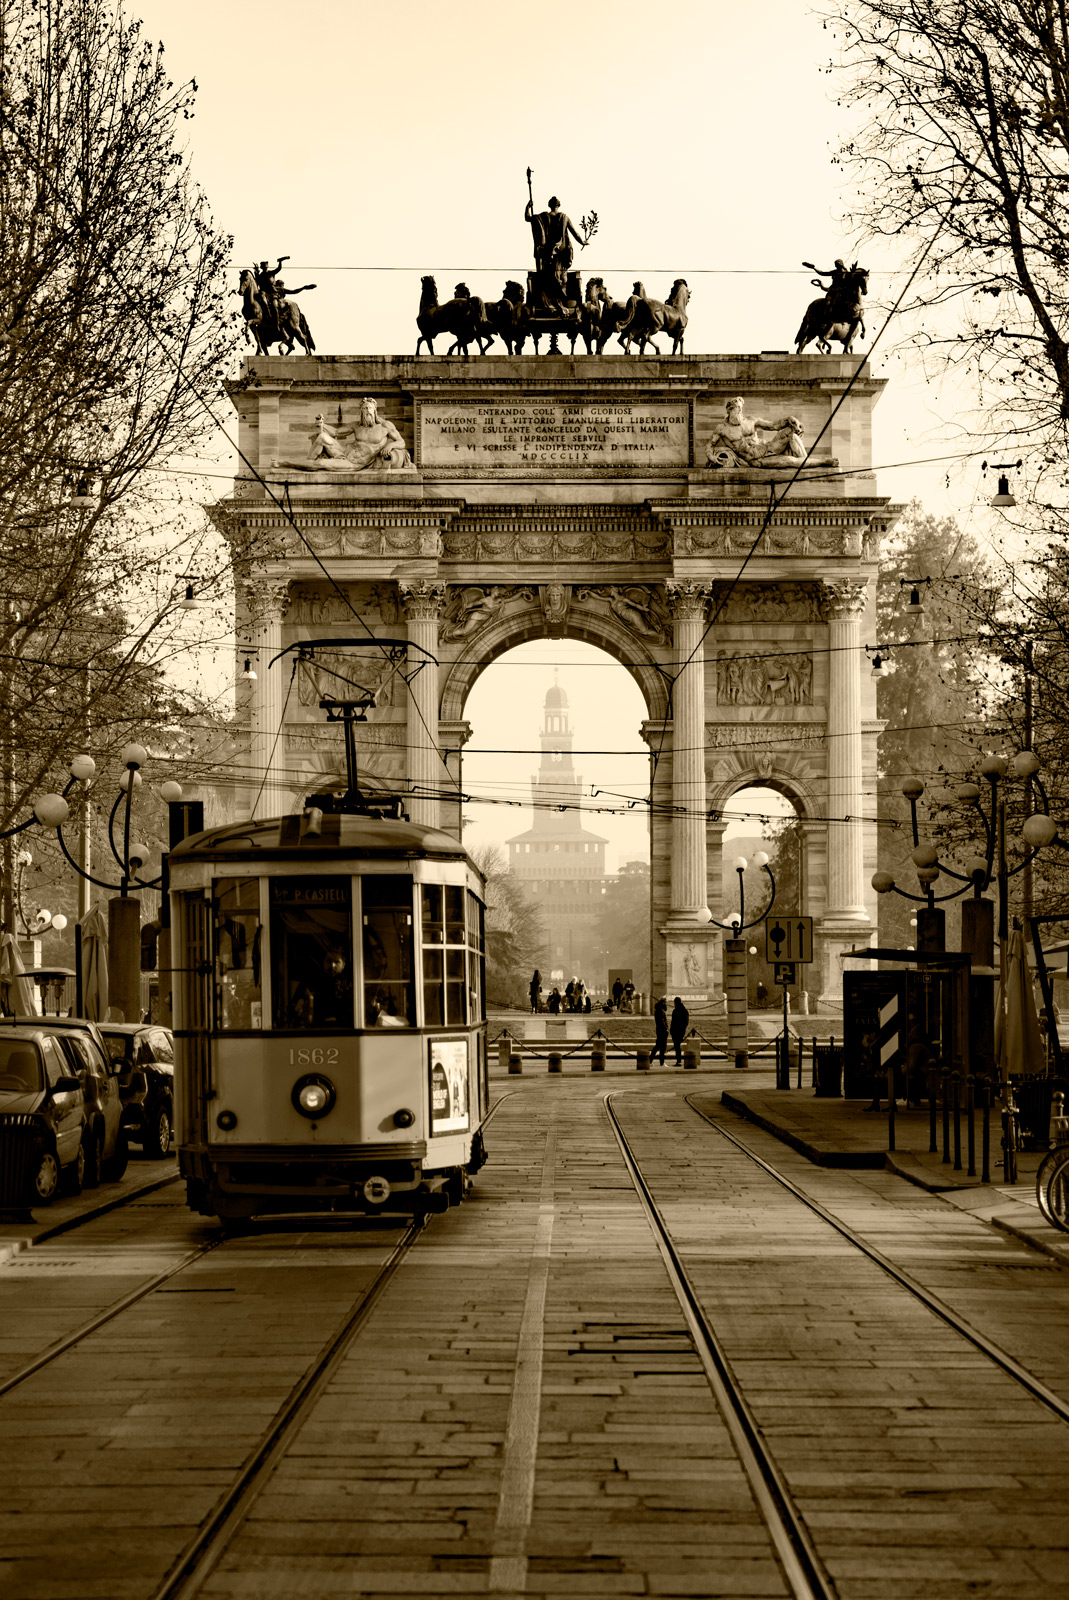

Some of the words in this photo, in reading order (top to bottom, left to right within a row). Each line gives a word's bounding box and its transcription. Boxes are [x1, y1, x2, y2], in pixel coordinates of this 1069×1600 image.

[478, 408, 526, 416] ENTRANDO
[425, 417, 477, 425] NAPOLEONE
[604, 426, 635, 434] QUESTI
[289, 1047, 339, 1065] 1862
